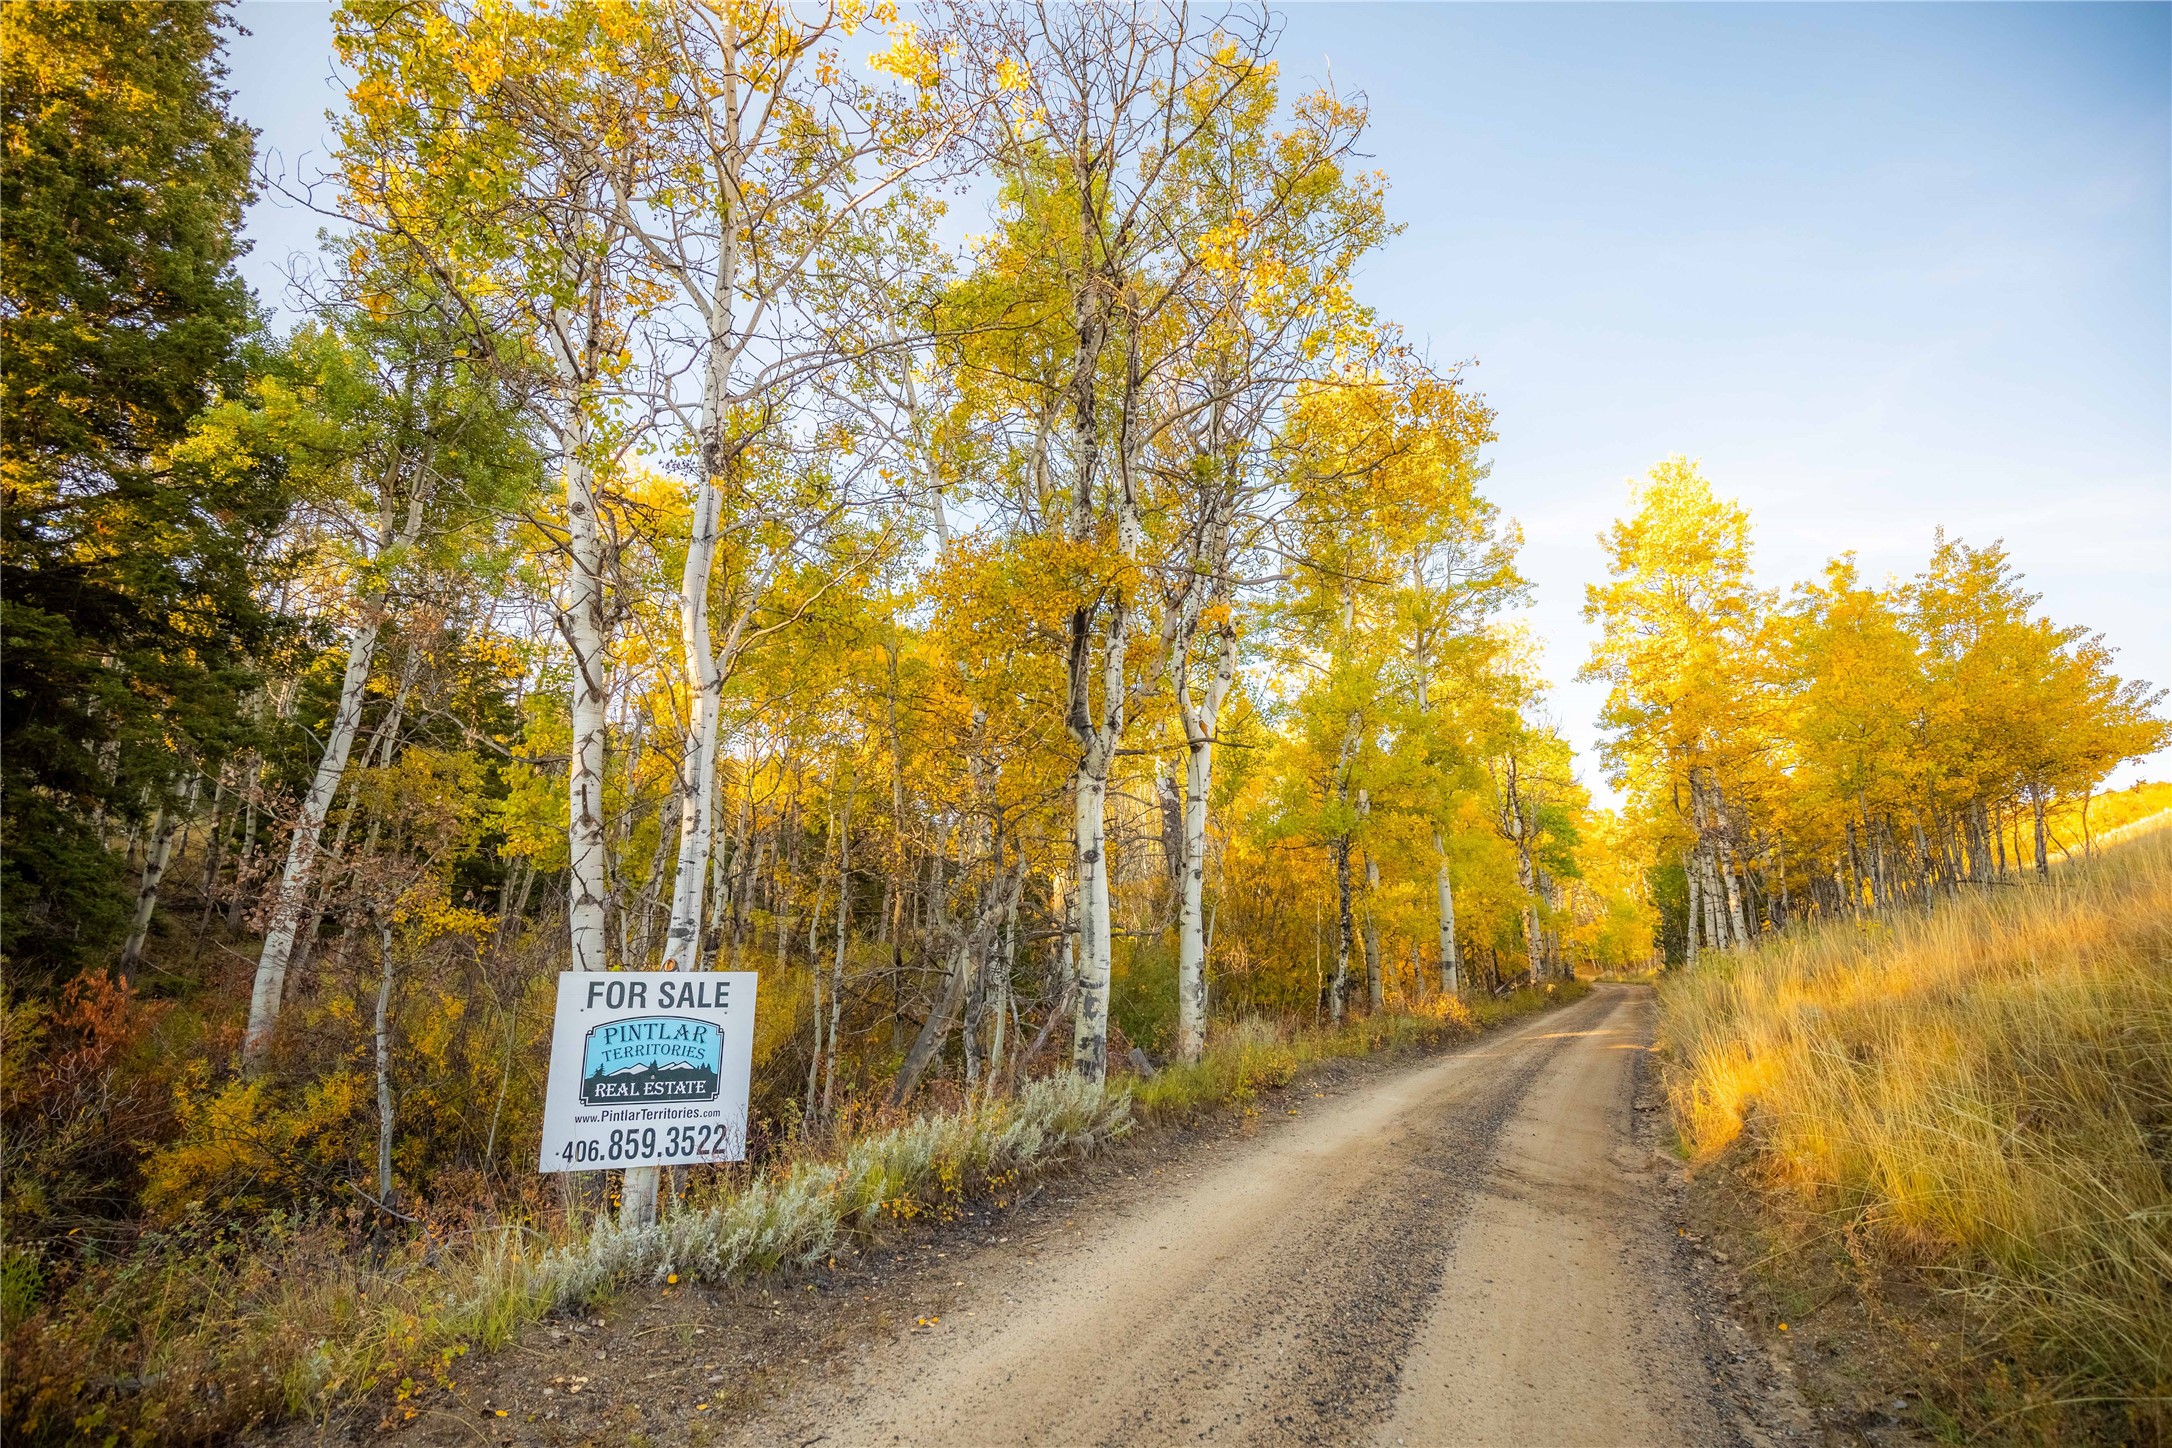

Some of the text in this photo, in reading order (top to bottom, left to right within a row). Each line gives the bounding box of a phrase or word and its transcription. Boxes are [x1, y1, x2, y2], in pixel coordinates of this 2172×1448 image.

[586, 981, 731, 1009] FOR SALE
[604, 1023, 708, 1045] PINTLAR
[601, 1043, 706, 1063] TERRITORIES
[594, 1080, 707, 1098] REAL ESTATE
[574, 1107, 721, 1124] www.PintlarTerritories.com
